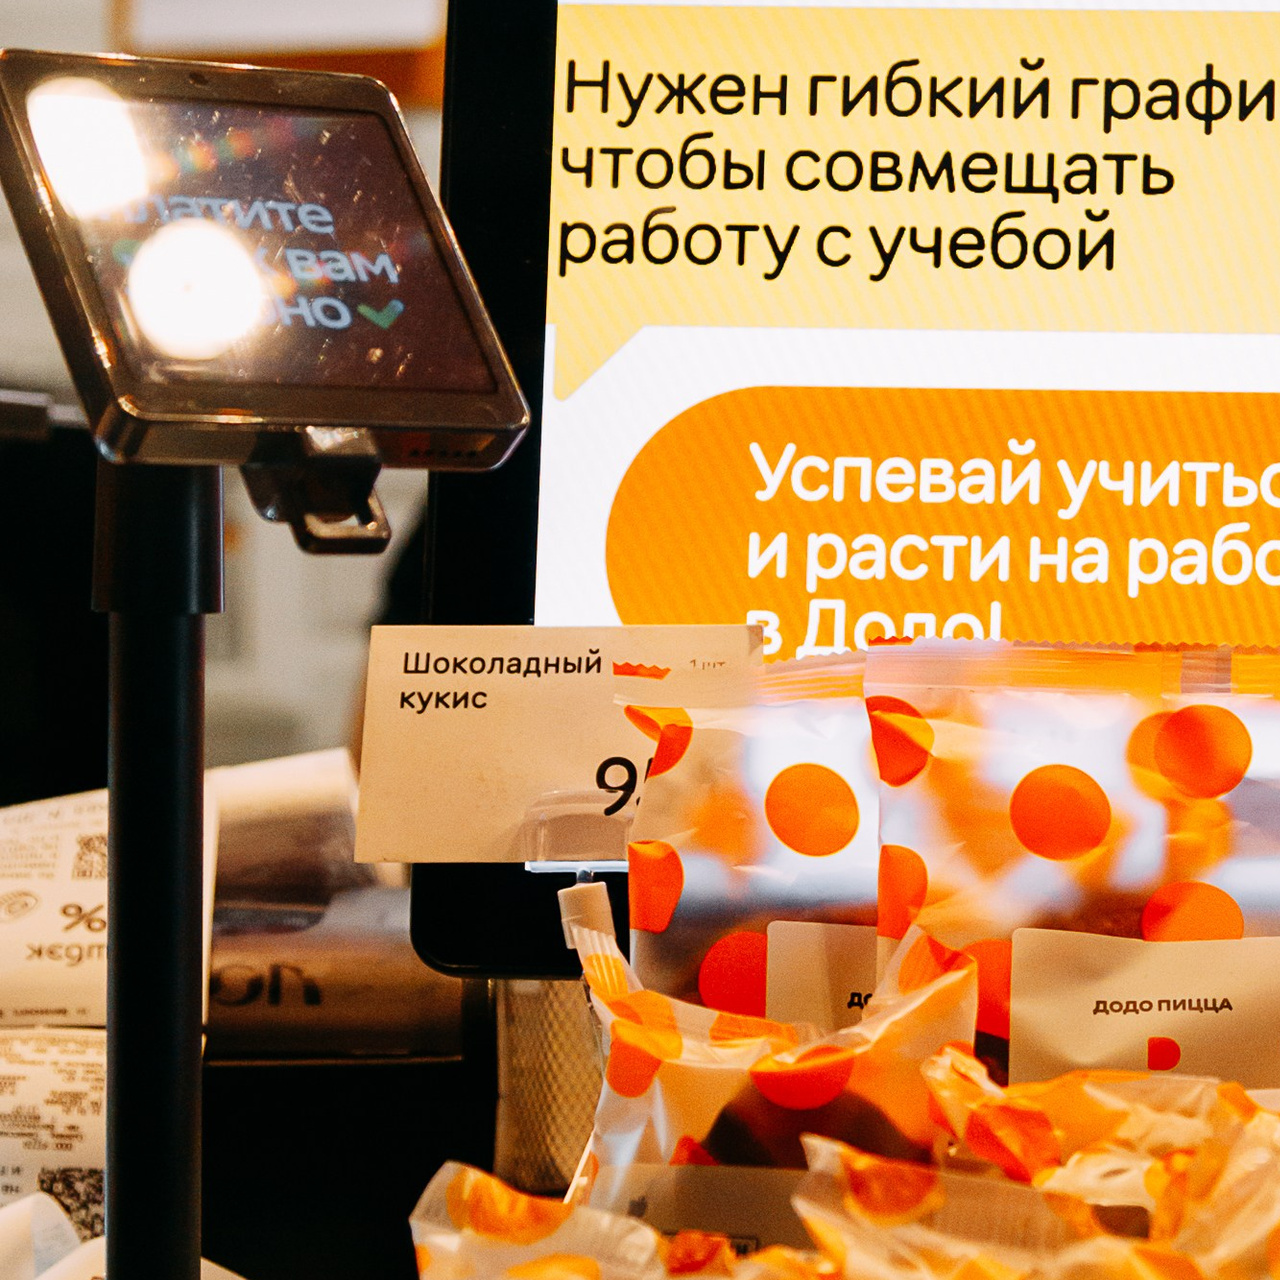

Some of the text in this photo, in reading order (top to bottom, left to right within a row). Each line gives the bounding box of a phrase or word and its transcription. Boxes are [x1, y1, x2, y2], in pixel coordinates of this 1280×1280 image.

[564, 60, 788, 125] Нужен
[809, 59, 1050, 121] гибкий
[558, 135, 1175, 200] чтобы совмещать
[558, 206, 1117, 281] работу с учебой
[748, 438, 1042, 504] Успевай
[745, 534, 788, 579] и
[806, 533, 1012, 594] расти
[1028, 539, 1106, 584] на
[746, 609, 783, 656] в
[403, 649, 602, 678] Шоколадный
[399, 690, 488, 715] кукис
[596, 756, 654, 817] 9
[1092, 997, 1233, 1015] ДОДО ПИЦЦА
